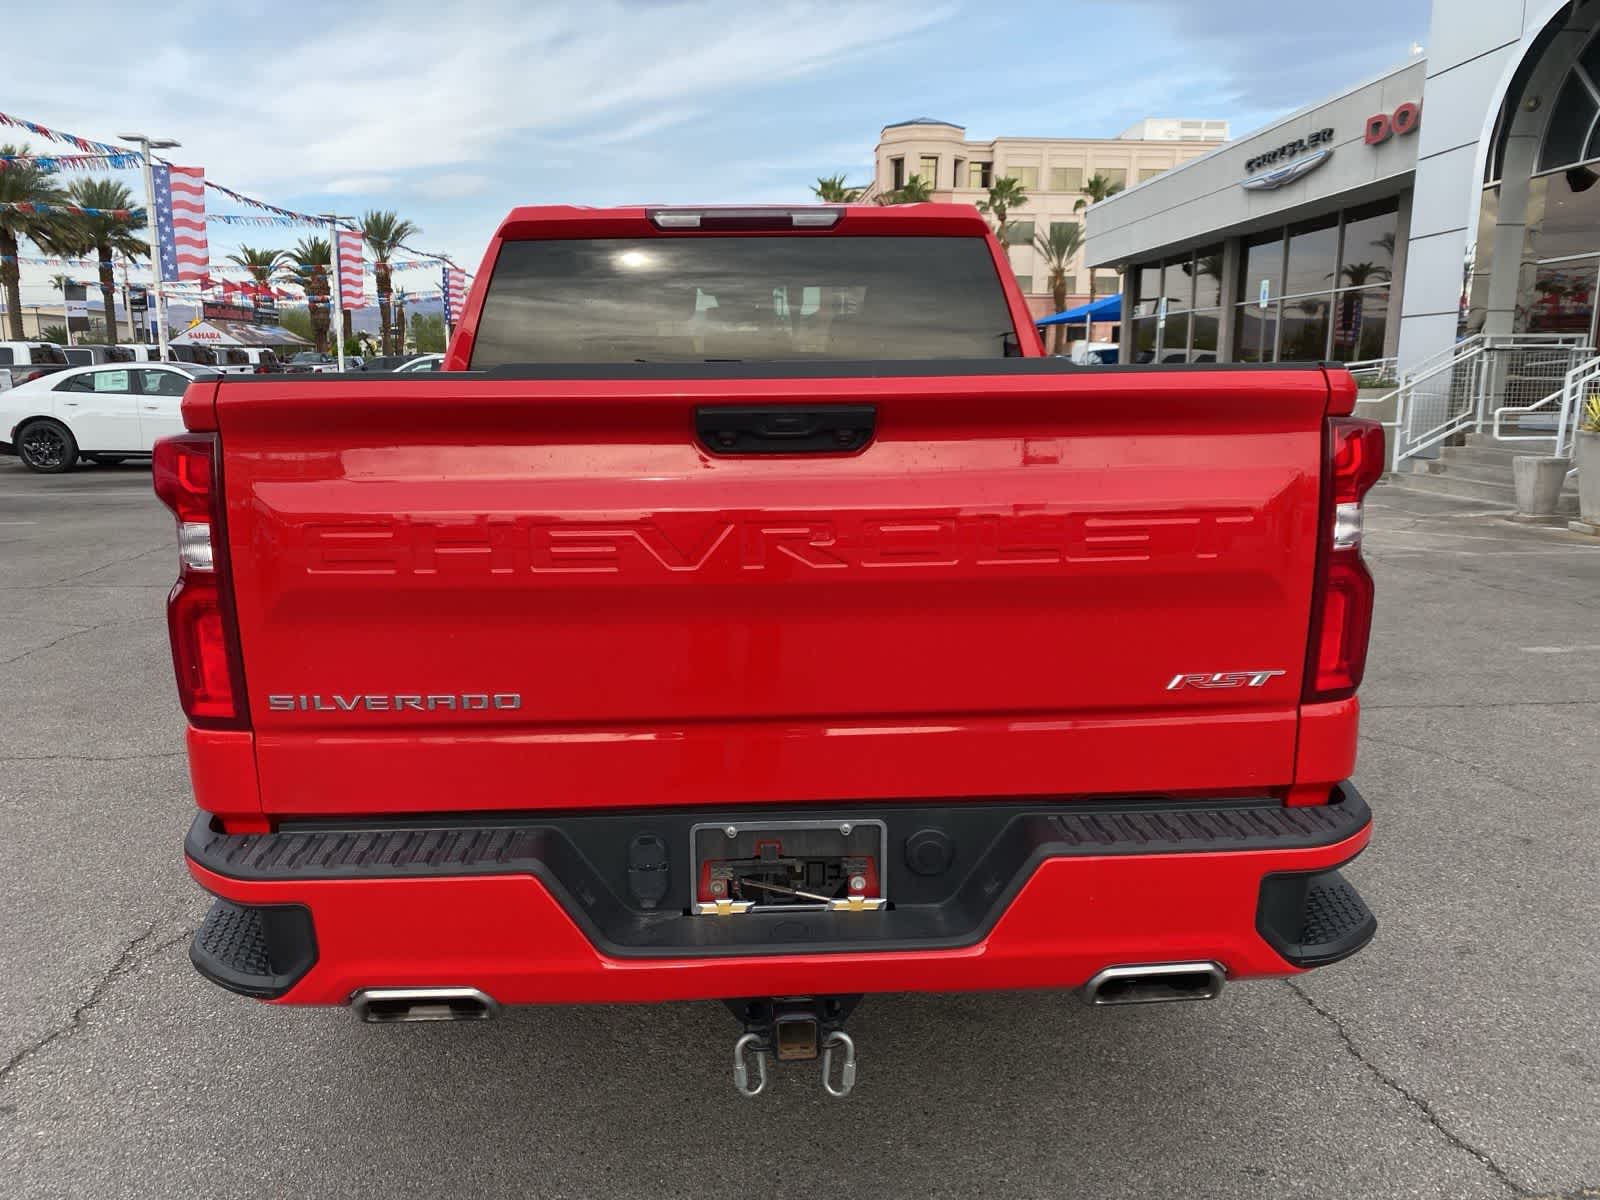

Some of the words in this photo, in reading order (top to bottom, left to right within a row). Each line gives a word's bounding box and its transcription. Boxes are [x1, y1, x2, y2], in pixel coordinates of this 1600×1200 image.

[1364, 98, 1423, 145] DO
[187, 331, 221, 340] SAHARA
[303, 508, 1256, 575] CHEVROLET
[1165, 669, 1287, 690] RST
[268, 693, 521, 712] SILVERADO
